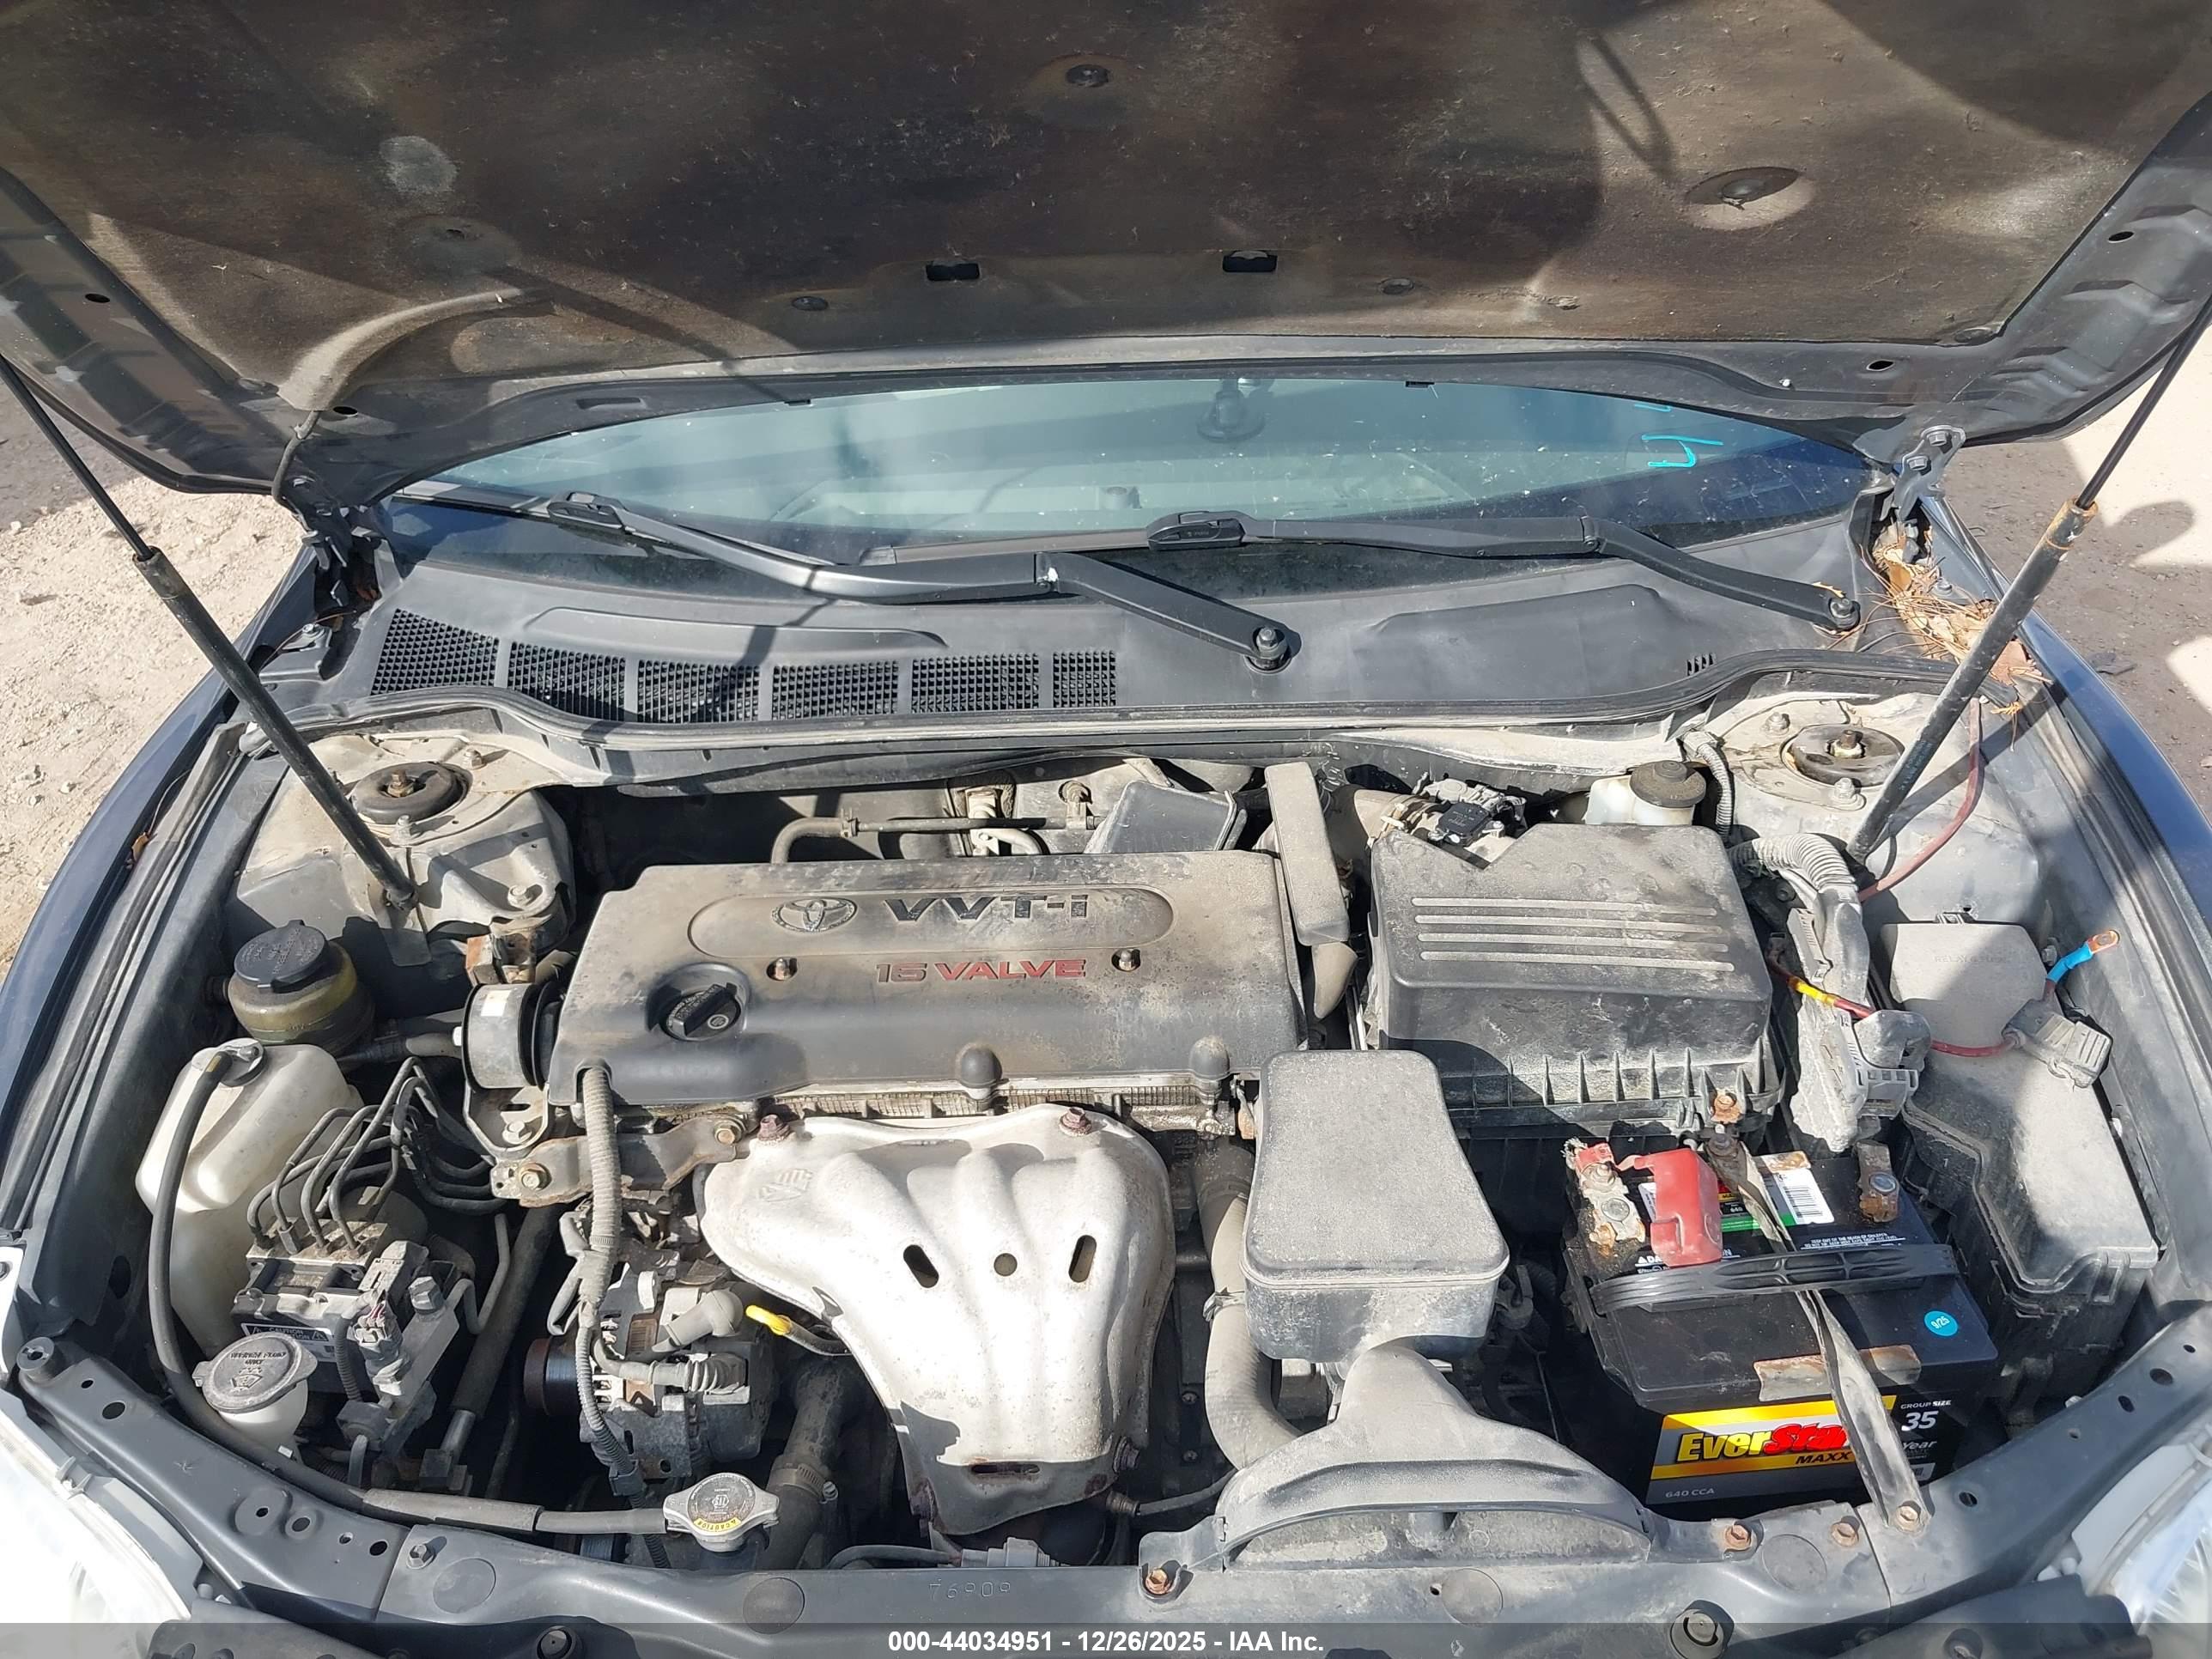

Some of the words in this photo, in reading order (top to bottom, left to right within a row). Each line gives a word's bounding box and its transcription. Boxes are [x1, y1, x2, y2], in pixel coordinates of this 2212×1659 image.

[884, 894, 1089, 922] VVT-i
[876, 963, 927, 983] 16
[933, 958, 1087, 981] VALVE
[1900, 1401, 1931, 1410] GROUP
[1900, 1410, 1940, 1432] 35
[1795, 1451, 1853, 1465] MAXX
[1665, 1490, 1690, 1498] 640
[1691, 1487, 1715, 1496] CCA
